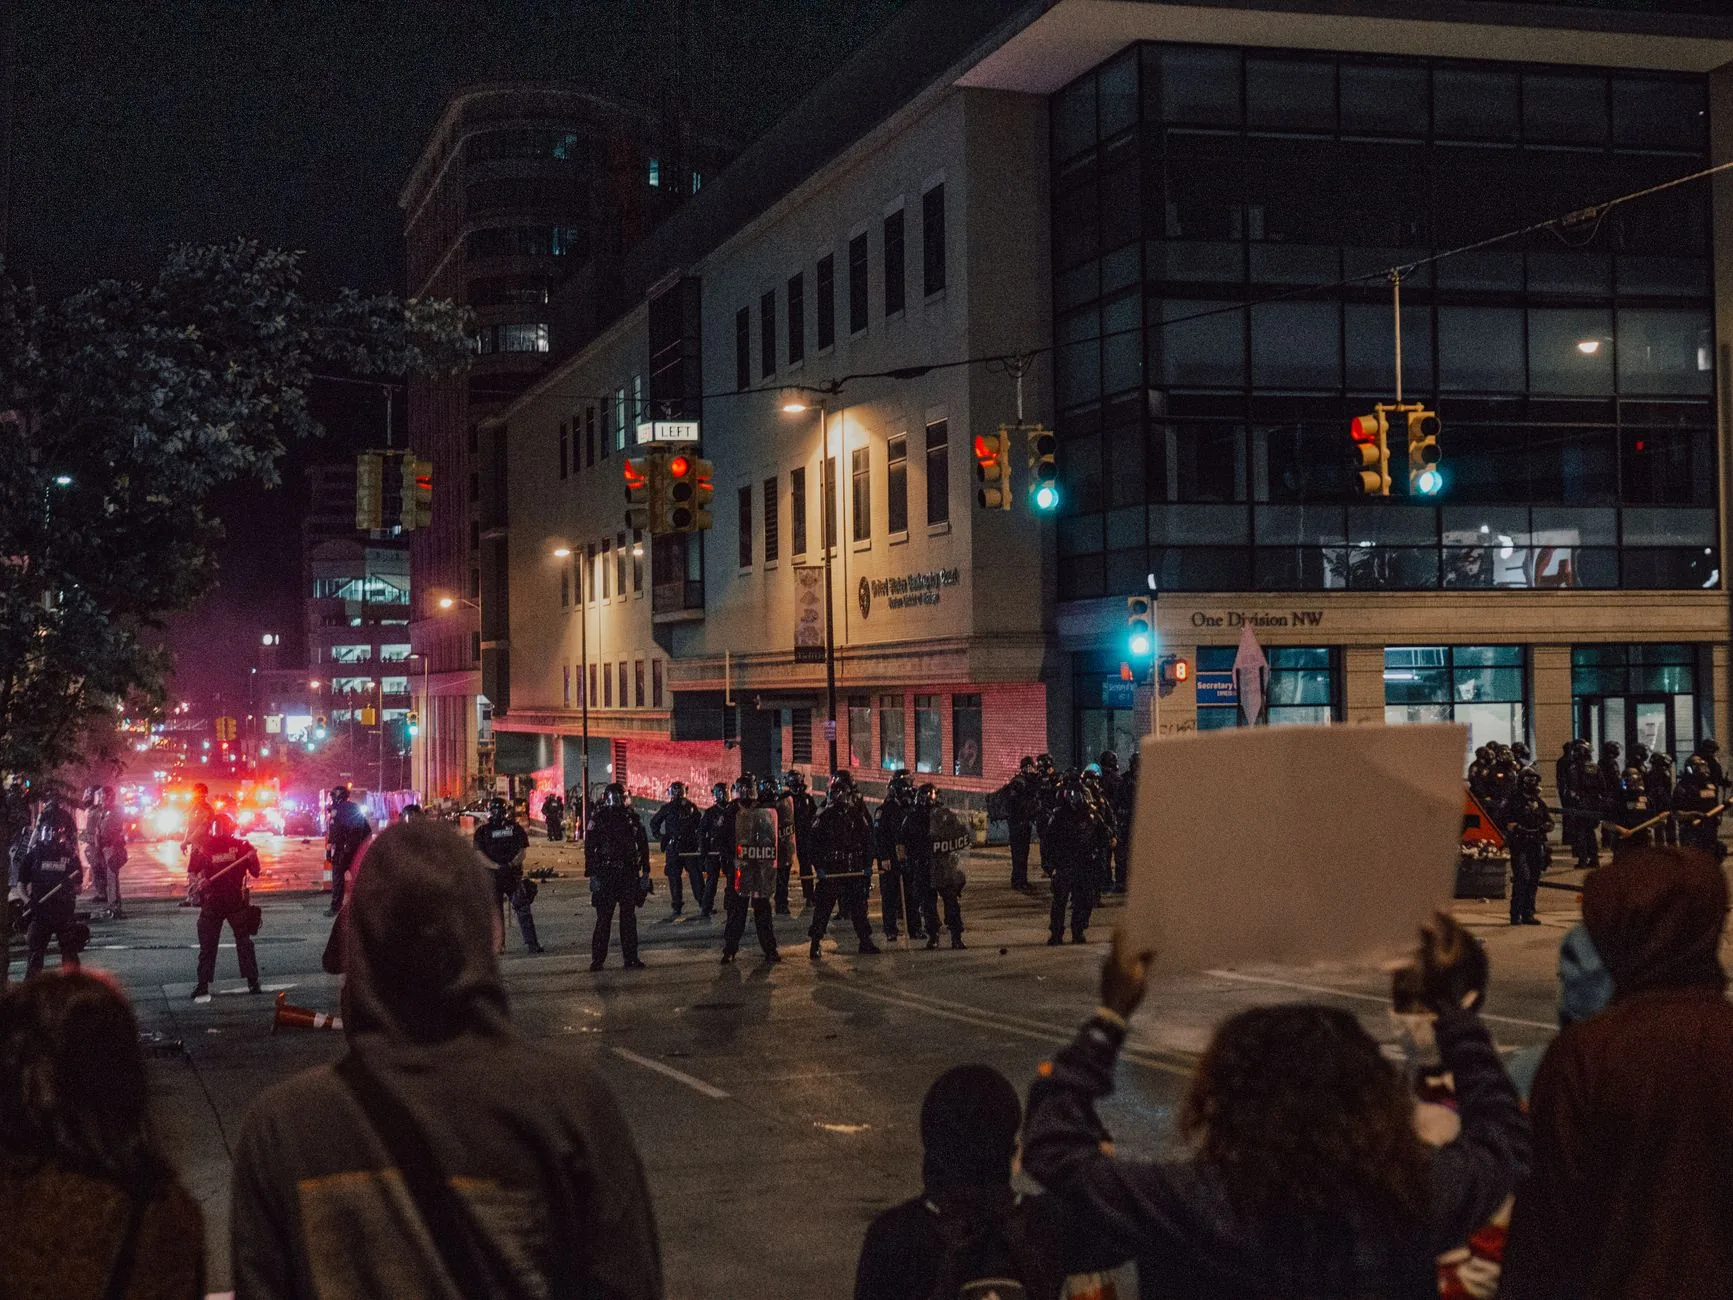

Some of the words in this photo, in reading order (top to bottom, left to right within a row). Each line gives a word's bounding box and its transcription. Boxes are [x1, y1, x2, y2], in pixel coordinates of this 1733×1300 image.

[661, 425, 691, 438] LEFT
[1191, 611, 1224, 627] One
[1228, 611, 1288, 627] Division
[1292, 611, 1323, 627] NW
[1197, 681, 1233, 691] Secretary
[933, 833, 969, 853] POLICE
[740, 846, 776, 859] POLICE
